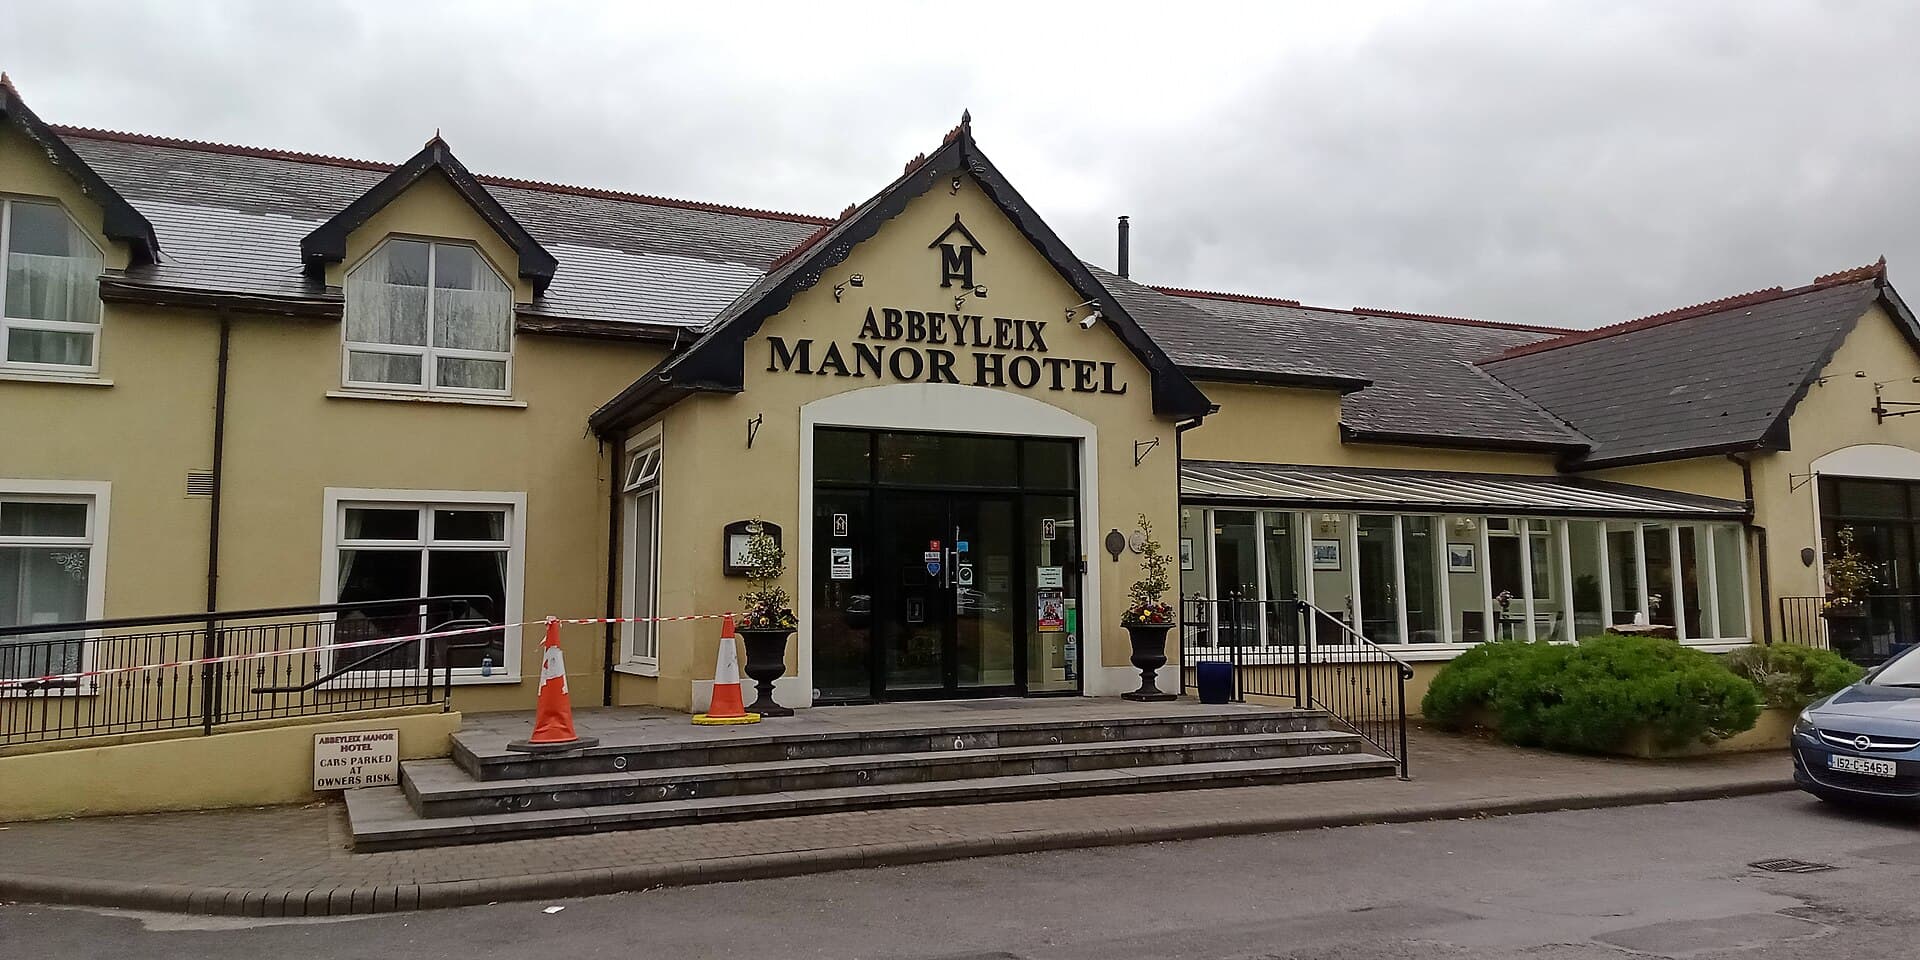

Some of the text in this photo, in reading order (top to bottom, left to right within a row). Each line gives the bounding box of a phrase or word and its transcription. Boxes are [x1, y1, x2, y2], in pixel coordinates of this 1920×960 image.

[859, 306, 1049, 353] ABBEYLEIX
[766, 336, 1128, 395] MANOR HOTEL
[319, 733, 394, 744] ABBEYLEIX MANOR
[340, 743, 373, 752] HOTEL
[320, 755, 392, 767] CARS PARKED
[349, 766, 363, 775] AT
[318, 774, 394, 786] OWNERS RISK.
